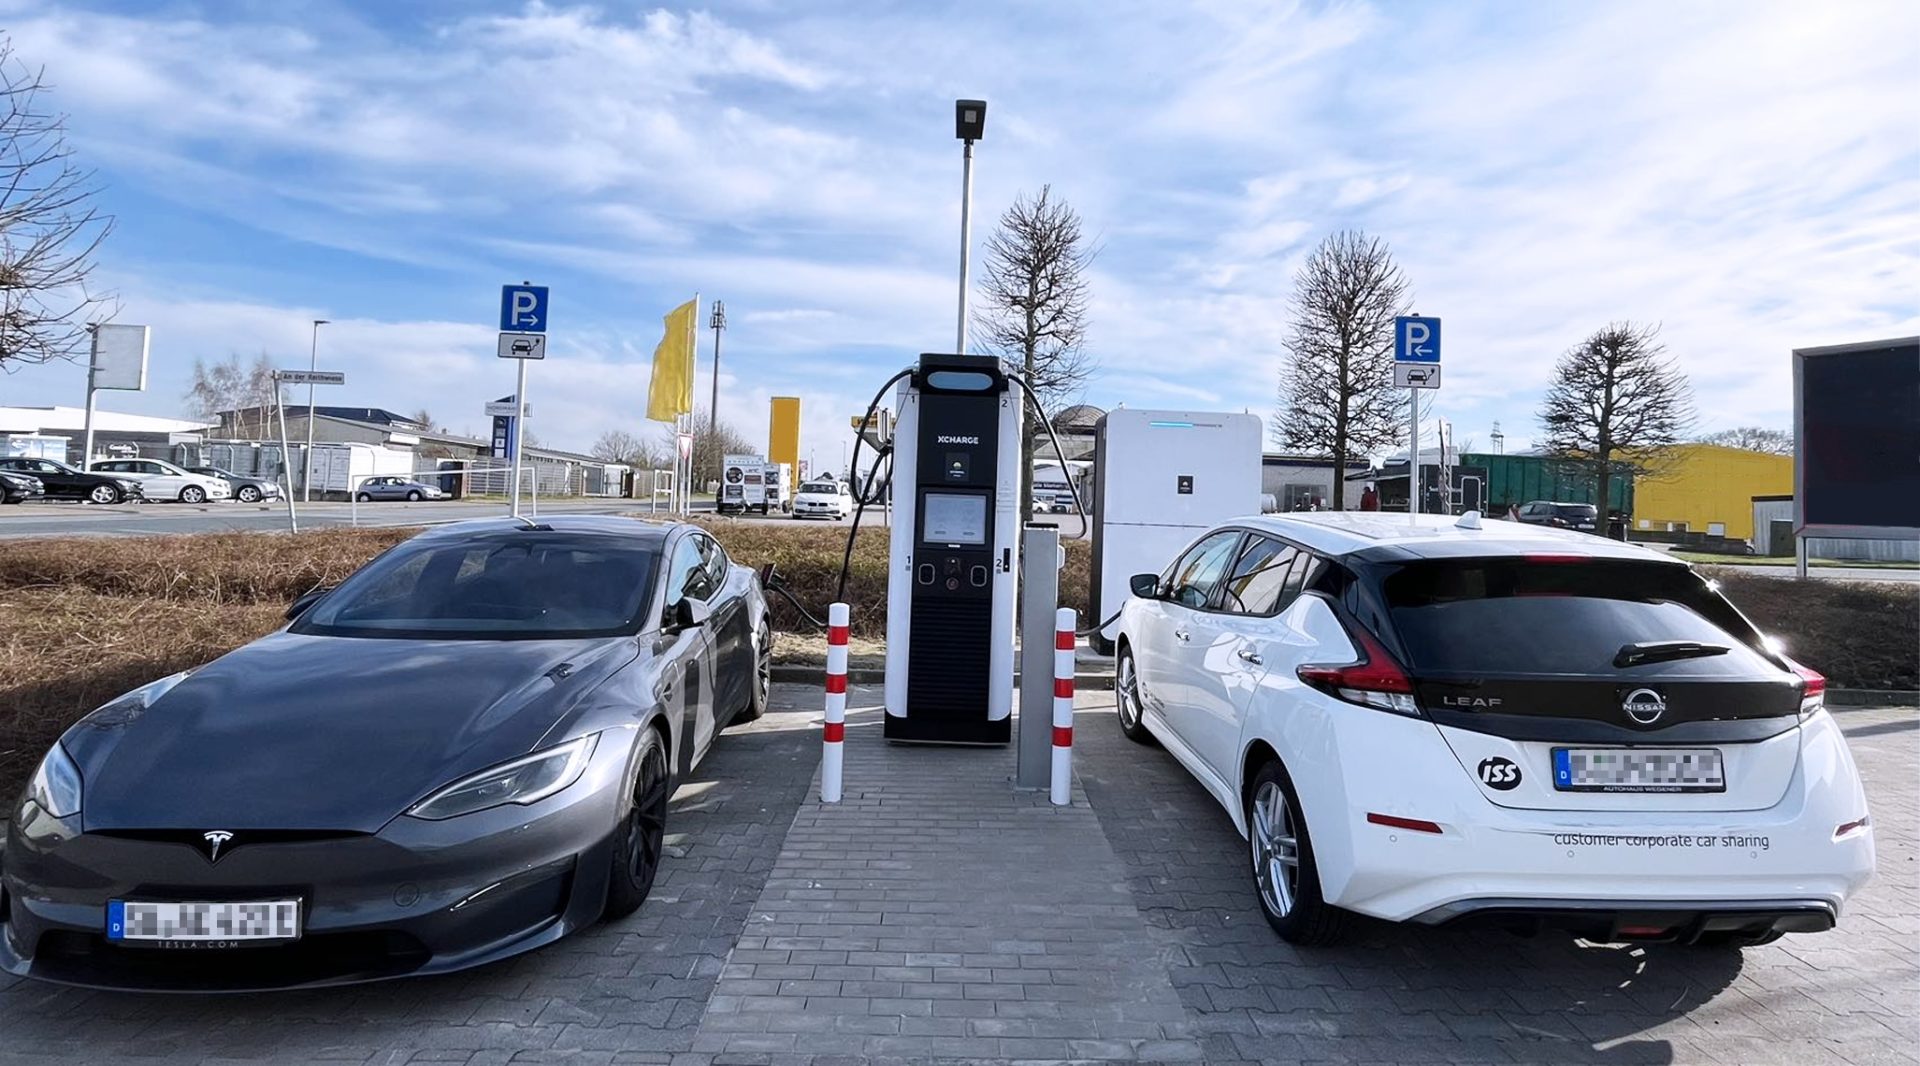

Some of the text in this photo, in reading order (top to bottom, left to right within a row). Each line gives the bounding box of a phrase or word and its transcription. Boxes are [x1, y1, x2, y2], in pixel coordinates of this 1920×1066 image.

[511, 291, 538, 326] P
[1405, 322, 1430, 356] P
[1001, 399, 1008, 408] 2
[937, 435, 979, 445] XCHARGE
[995, 558, 1002, 567] 2
[1443, 696, 1502, 707] LEAF
[1622, 702, 1666, 711] NISSAN
[1560, 770, 1567, 779] D
[1554, 833, 1769, 850] customer corporate car sharing
[113, 923, 120, 932] D
[158, 941, 239, 949] TESLA.COM
